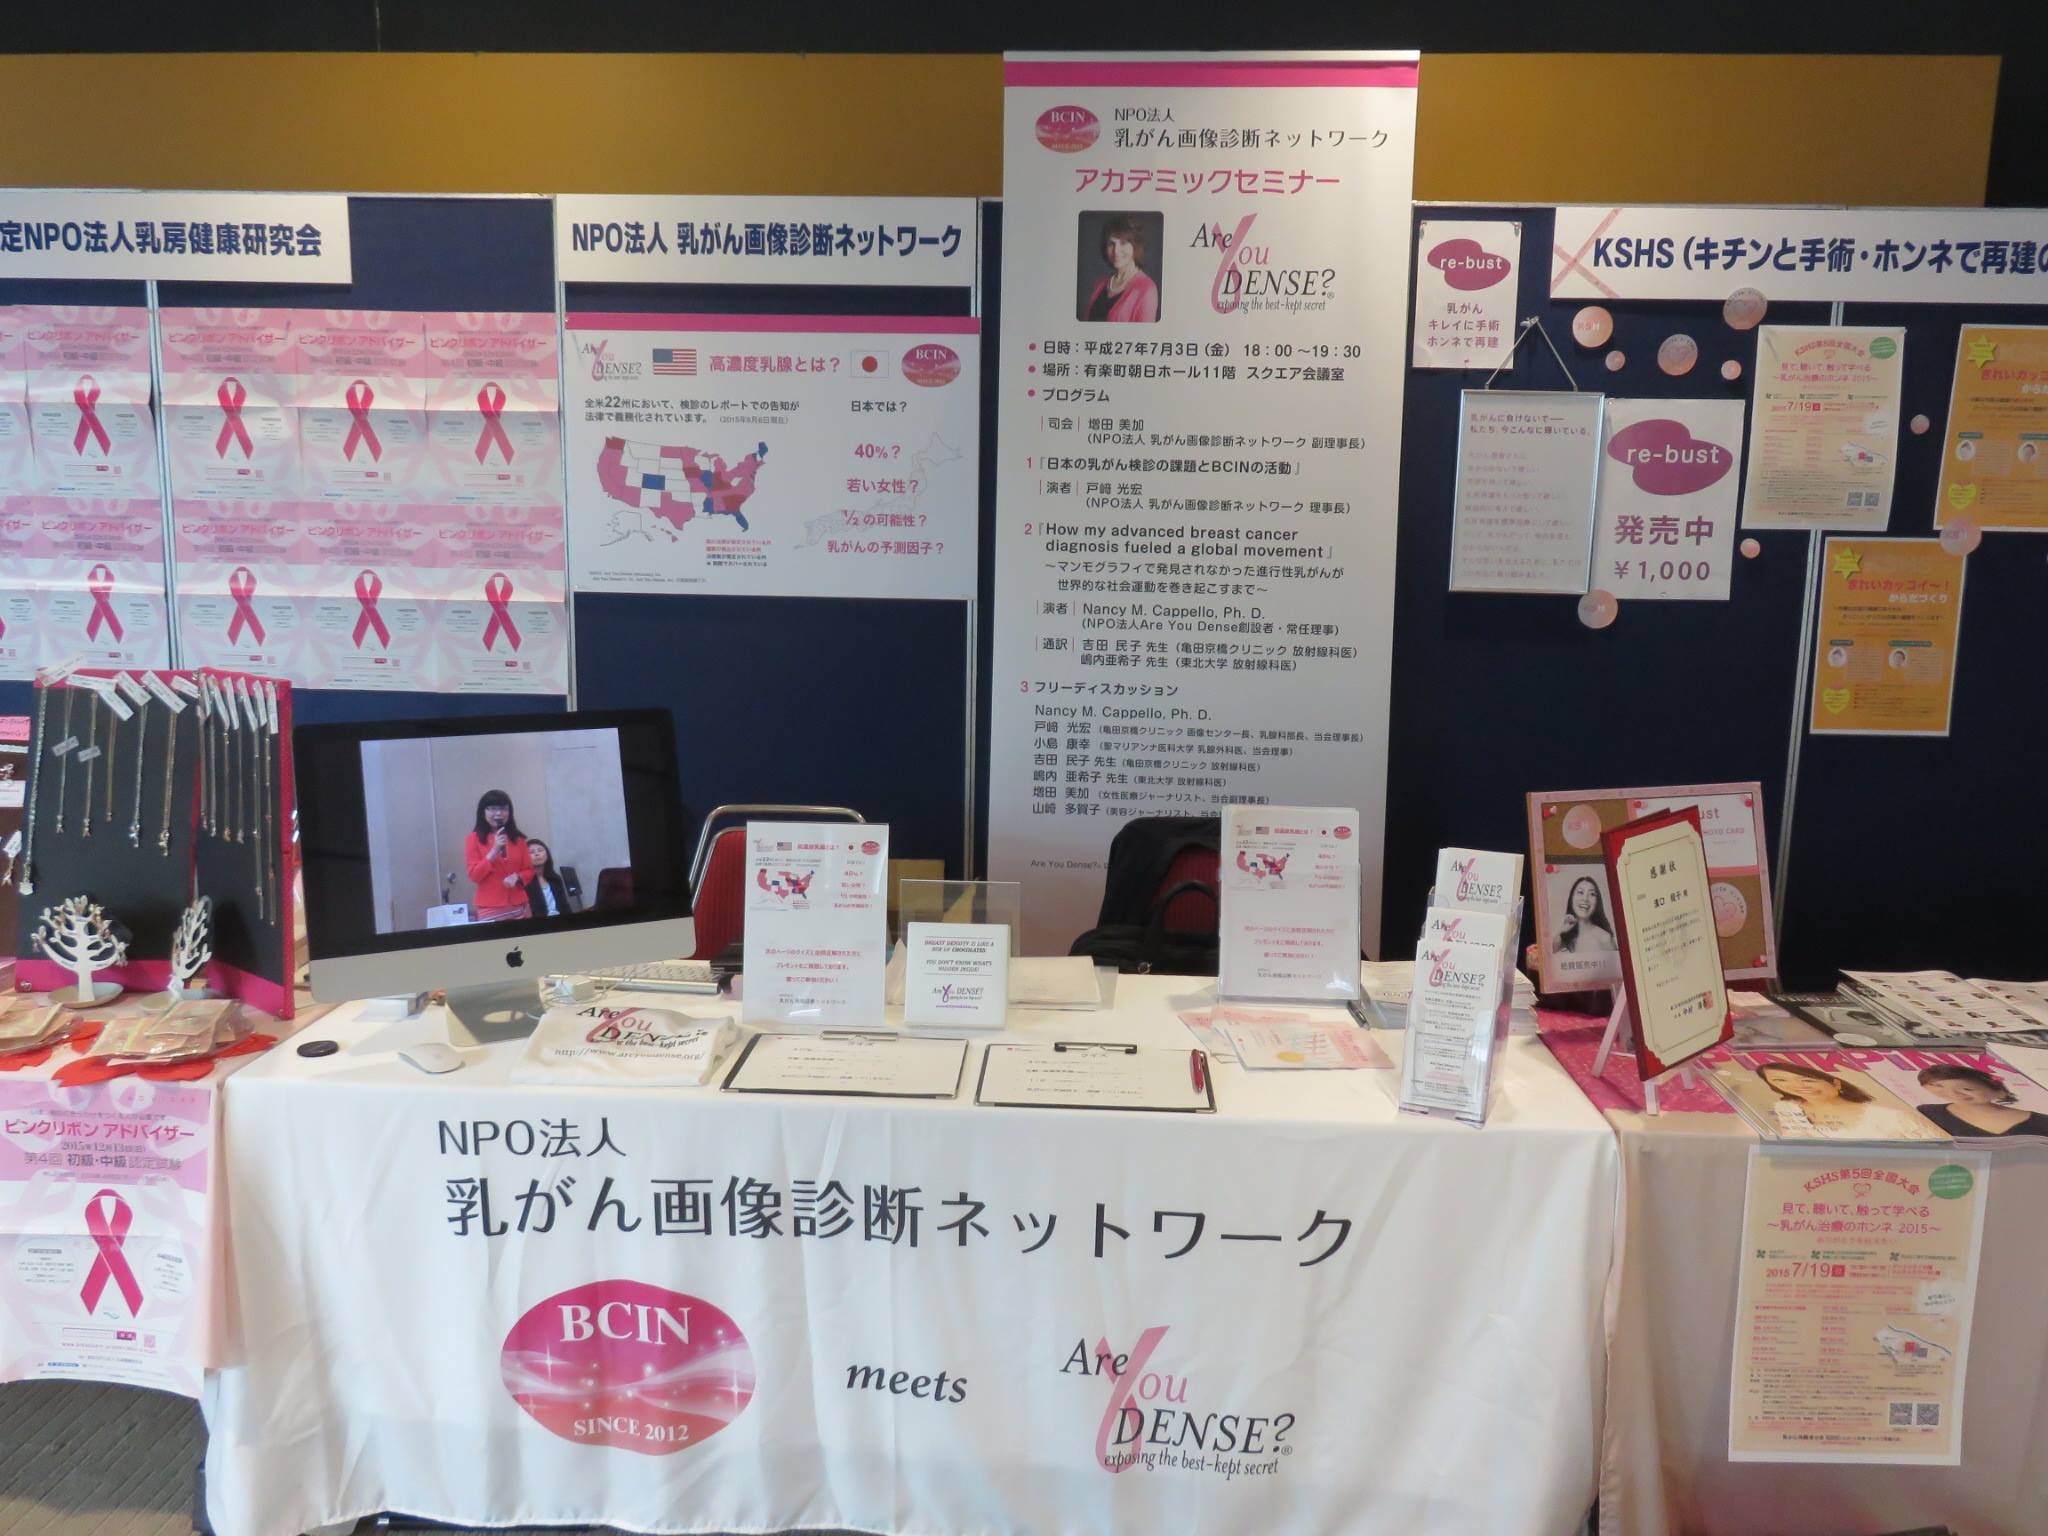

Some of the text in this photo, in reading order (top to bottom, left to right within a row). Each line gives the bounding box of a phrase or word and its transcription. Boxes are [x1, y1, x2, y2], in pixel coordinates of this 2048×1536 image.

[1050, 111, 1085, 123] BCIN
[1114, 108, 1175, 122] NPO法人
[1114, 128, 1389, 149] 乳がん画像診断ネットワーク
[1075, 168, 1340, 194] アカデミックセミナー
[572, 221, 962, 258] NPO法人 乳がん画像診断ネットワーク
[1191, 222, 1233, 249] Are
[1593, 237, 1674, 269] KSHS
[1440, 256, 1502, 269] re-bust
[1251, 298, 1264, 312] the
[1265, 299, 1302, 315] best-kept
[1303, 301, 1326, 312] secret
[1447, 303, 1483, 314] 乳がん
[1428, 320, 1500, 332] キレイに手術
[1427, 336, 1499, 348] ホンネで再建
[915, 349, 947, 360] BCIN
[709, 355, 840, 373] 高濃度乳腺とは？
[1247, 366, 1346, 382] スクエア会議室
[1042, 388, 1110, 403] プログラム
[850, 400, 907, 413] 日本では？
[1048, 417, 1073, 431] 司会
[1119, 418, 1144, 432] 美加
[1150, 434, 1307, 449] 乳がん画像診断ネットワーク
[1627, 445, 1719, 464] re-bust
[846, 478, 919, 494] 若い女性？
[1046, 481, 1143, 497] 演者 光宏
[1148, 498, 1305, 513] 乳がん画像診断ネットワーク
[1024, 523, 1033, 535] 2
[1084, 526, 1106, 539] my
[1111, 524, 1185, 539] advanced
[1190, 526, 1241, 541] breast
[1245, 528, 1299, 541] cancer
[1615, 515, 1714, 546] 発売中
[827, 541, 944, 556] 乳がんの予測因子？
[1045, 540, 1119, 556] diagnosis
[1124, 540, 1174, 554] fueled
[1177, 544, 1186, 555] a
[1190, 542, 1239, 558] global
[1042, 602, 1266, 621] 演者 Nancy M. Cappello, Ph. D.
[1168, 620, 1192, 632] You
[1042, 638, 1068, 651] 通訳
[1082, 638, 1109, 652] 吉田
[1116, 639, 1142, 653] 民子
[1146, 641, 1168, 654] 先生
[1145, 655, 1168, 668] 先生
[1020, 681, 1179, 697] 3 フリーディスカッション
[1035, 704, 1212, 721] Nancy M. Cappello, Ph. D.
[1066, 722, 1091, 735] 光宏
[1034, 738, 1058, 751] 小島
[1034, 754, 1058, 767] 吉田
[1066, 754, 1091, 768] 民子
[1094, 755, 1117, 768] 先生
[1065, 770, 1102, 784] 亜希子
[1105, 772, 1128, 784] 先生
[1065, 787, 1089, 800] 美加
[576, 1006, 621, 1019] Are
[5, 1120, 195, 1141] ピンクリボン アドバイザー
[438, 1117, 627, 1159] NPO法人
[67, 1153, 127, 1168] 初級・中級
[1782, 1203, 1930, 1218] 見て、聴いて、触って学べる
[446, 1175, 1352, 1267] 乳がん画像診断ネットワーク
[1766, 1263, 1830, 1278] 2015 7/19
[557, 1301, 692, 1345] BCIN
[1059, 1338, 1128, 1377] Are
[846, 1362, 968, 1403] meets
[574, 1416, 689, 1441] SINCE 2012
[1104, 1447, 1279, 1480] exposing the best-kept secret
